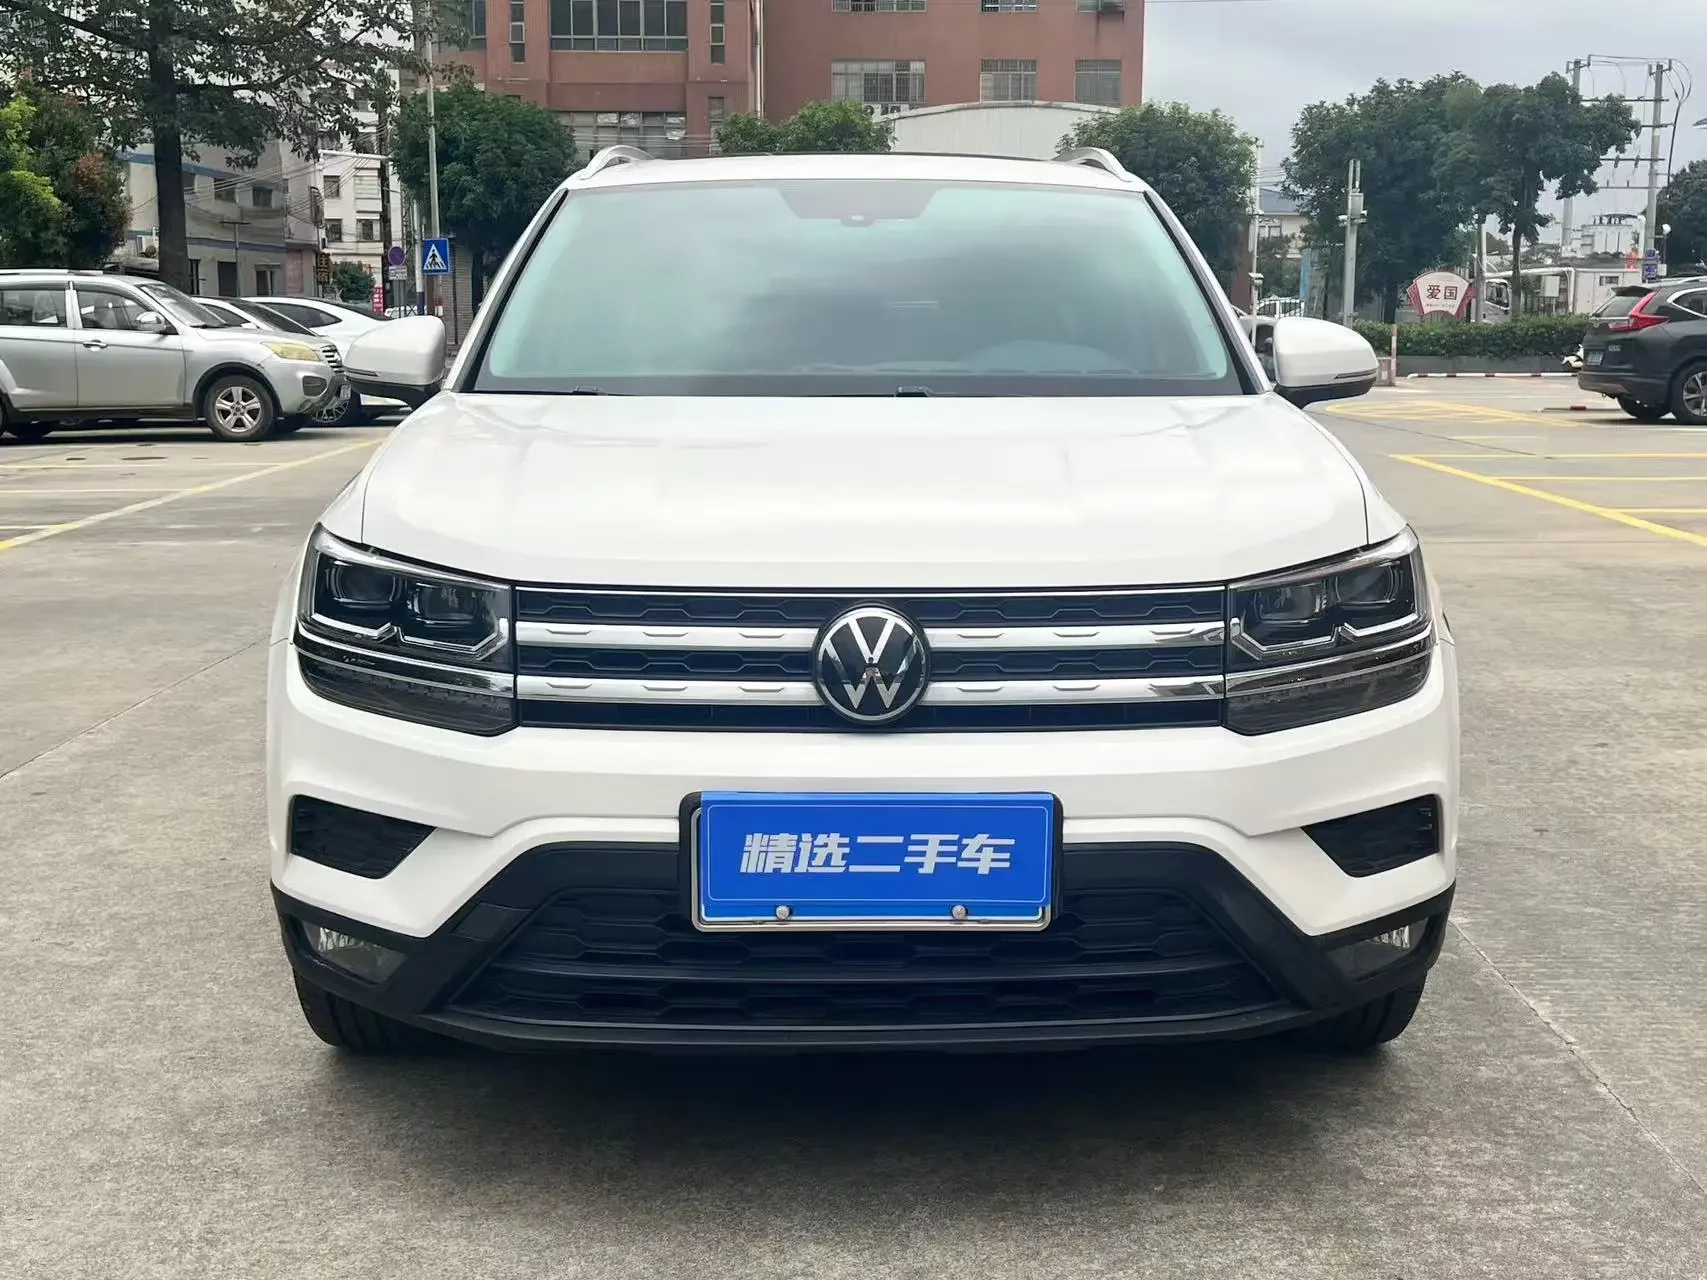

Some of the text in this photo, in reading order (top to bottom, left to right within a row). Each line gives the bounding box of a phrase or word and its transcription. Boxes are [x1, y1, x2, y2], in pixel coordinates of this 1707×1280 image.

[1426, 284, 1458, 300] 爱国
[739, 833, 1016, 875] 精选二手车
